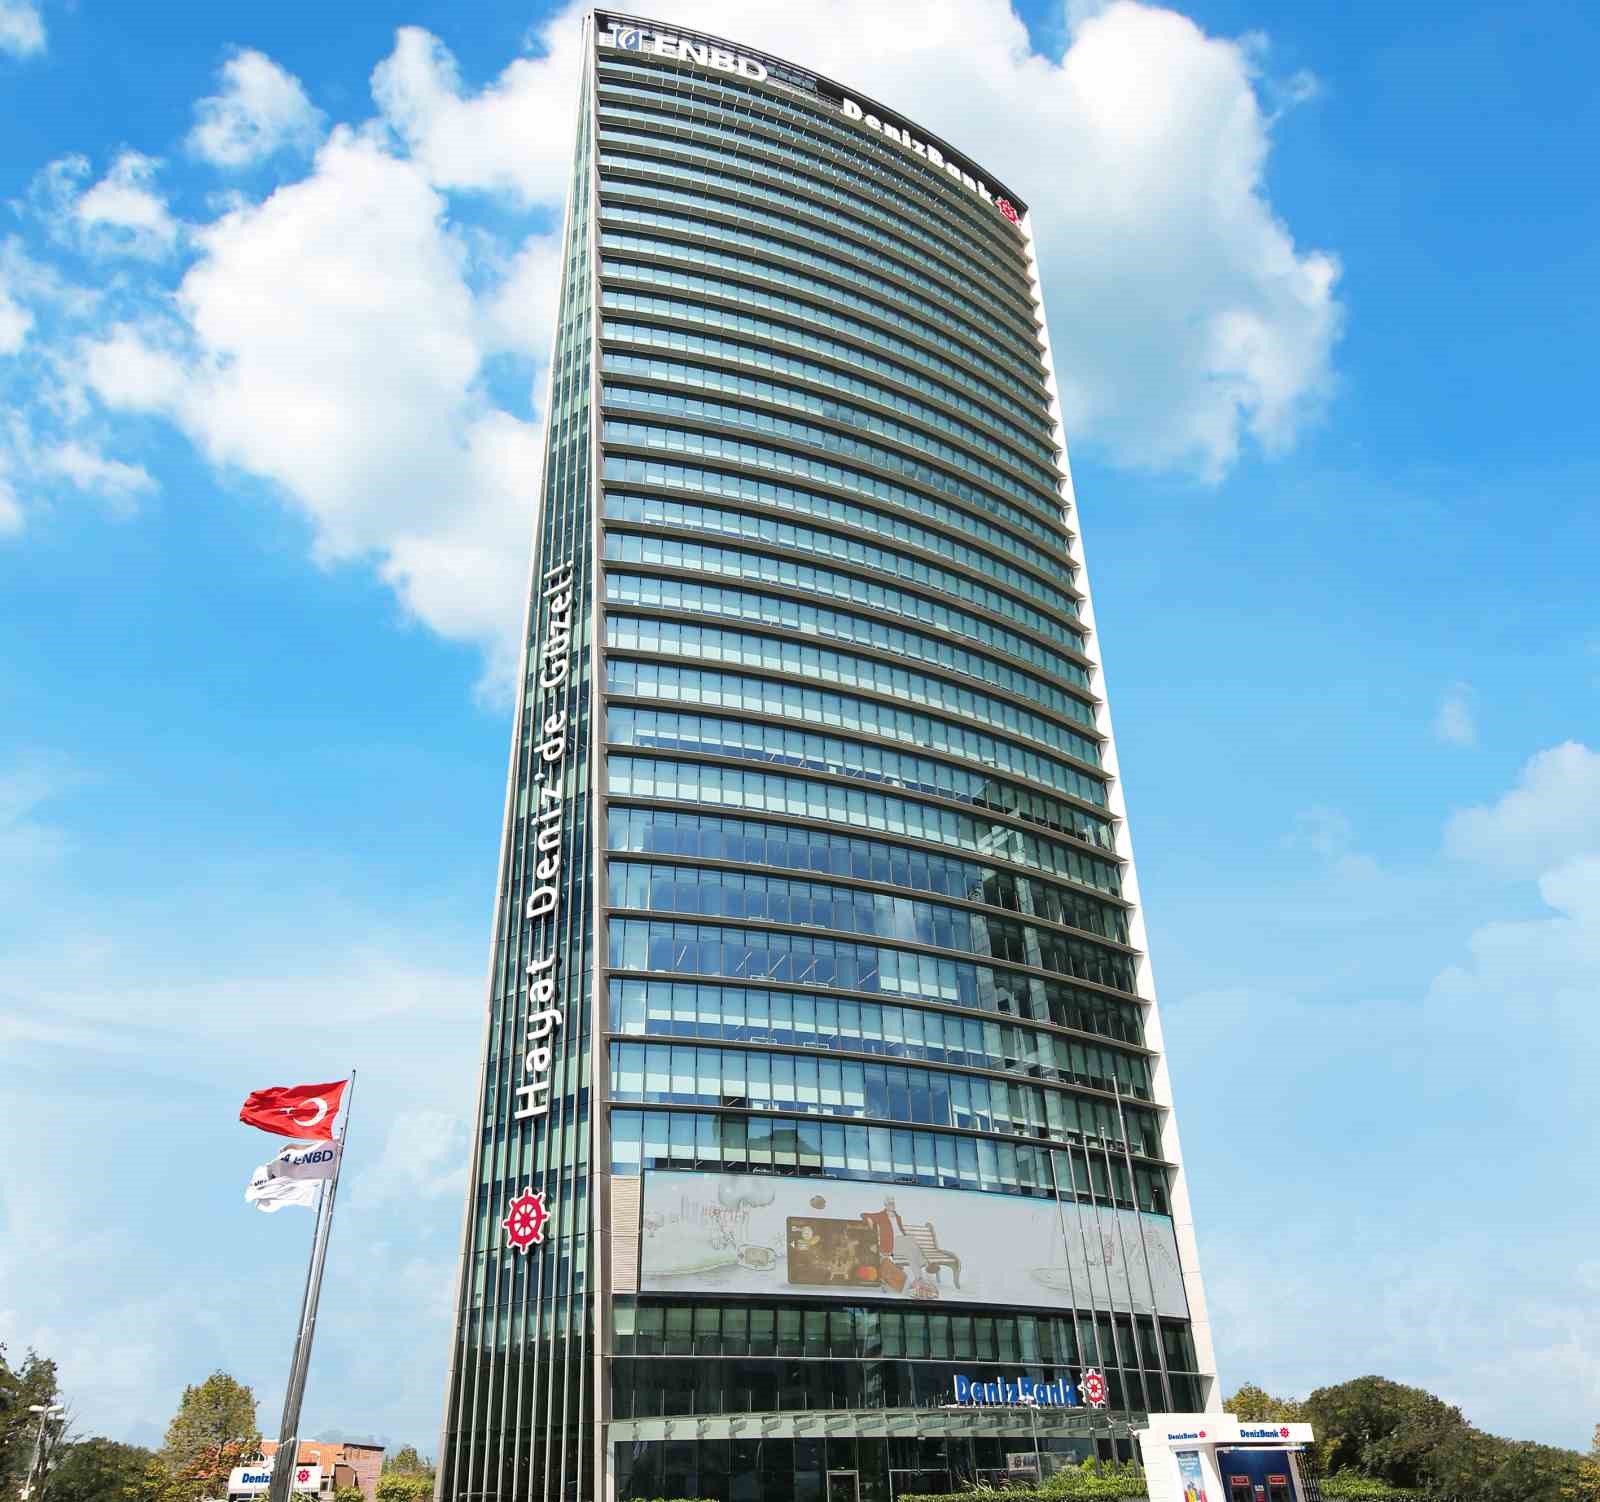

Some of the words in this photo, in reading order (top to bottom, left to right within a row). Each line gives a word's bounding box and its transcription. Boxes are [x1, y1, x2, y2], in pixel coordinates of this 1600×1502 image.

[654, 31, 768, 82] ENBD
[842, 97, 996, 207] DenizBank
[514, 953, 562, 1119] Hayat
[540, 559, 573, 688] Güzel!
[953, 1374, 1078, 1405] DenizBank
[1240, 1429, 1279, 1438] DenizBank
[242, 1472, 272, 1484] Deniz
